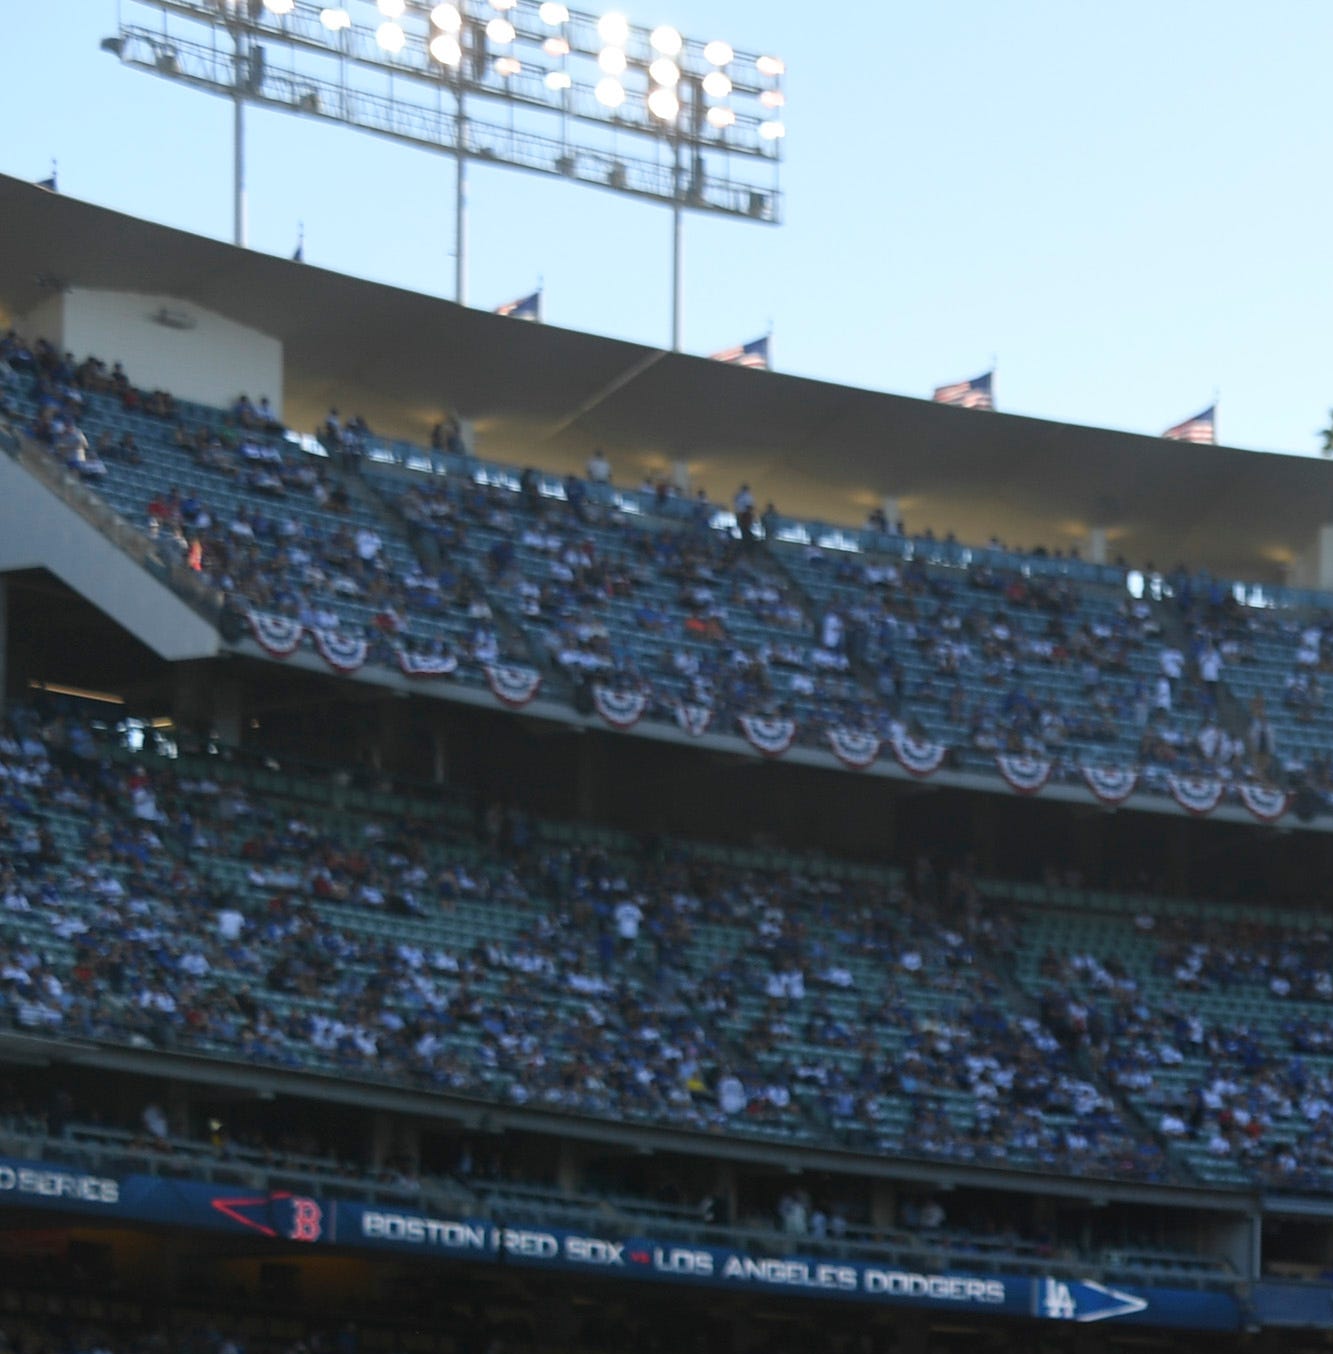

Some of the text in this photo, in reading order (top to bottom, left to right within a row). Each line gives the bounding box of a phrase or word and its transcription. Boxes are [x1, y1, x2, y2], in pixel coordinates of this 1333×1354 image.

[18, 1166, 119, 1203] SERIES
[290, 1197, 321, 1242] B
[362, 1210, 485, 1249] BOSTON
[491, 1229, 559, 1259] RED
[565, 1236, 625, 1266] SOX
[653, 1246, 714, 1277] LOS
[723, 1254, 857, 1291] ANGELES
[864, 1269, 1006, 1304] DODGERS
[1043, 1276, 1077, 1319] LA
